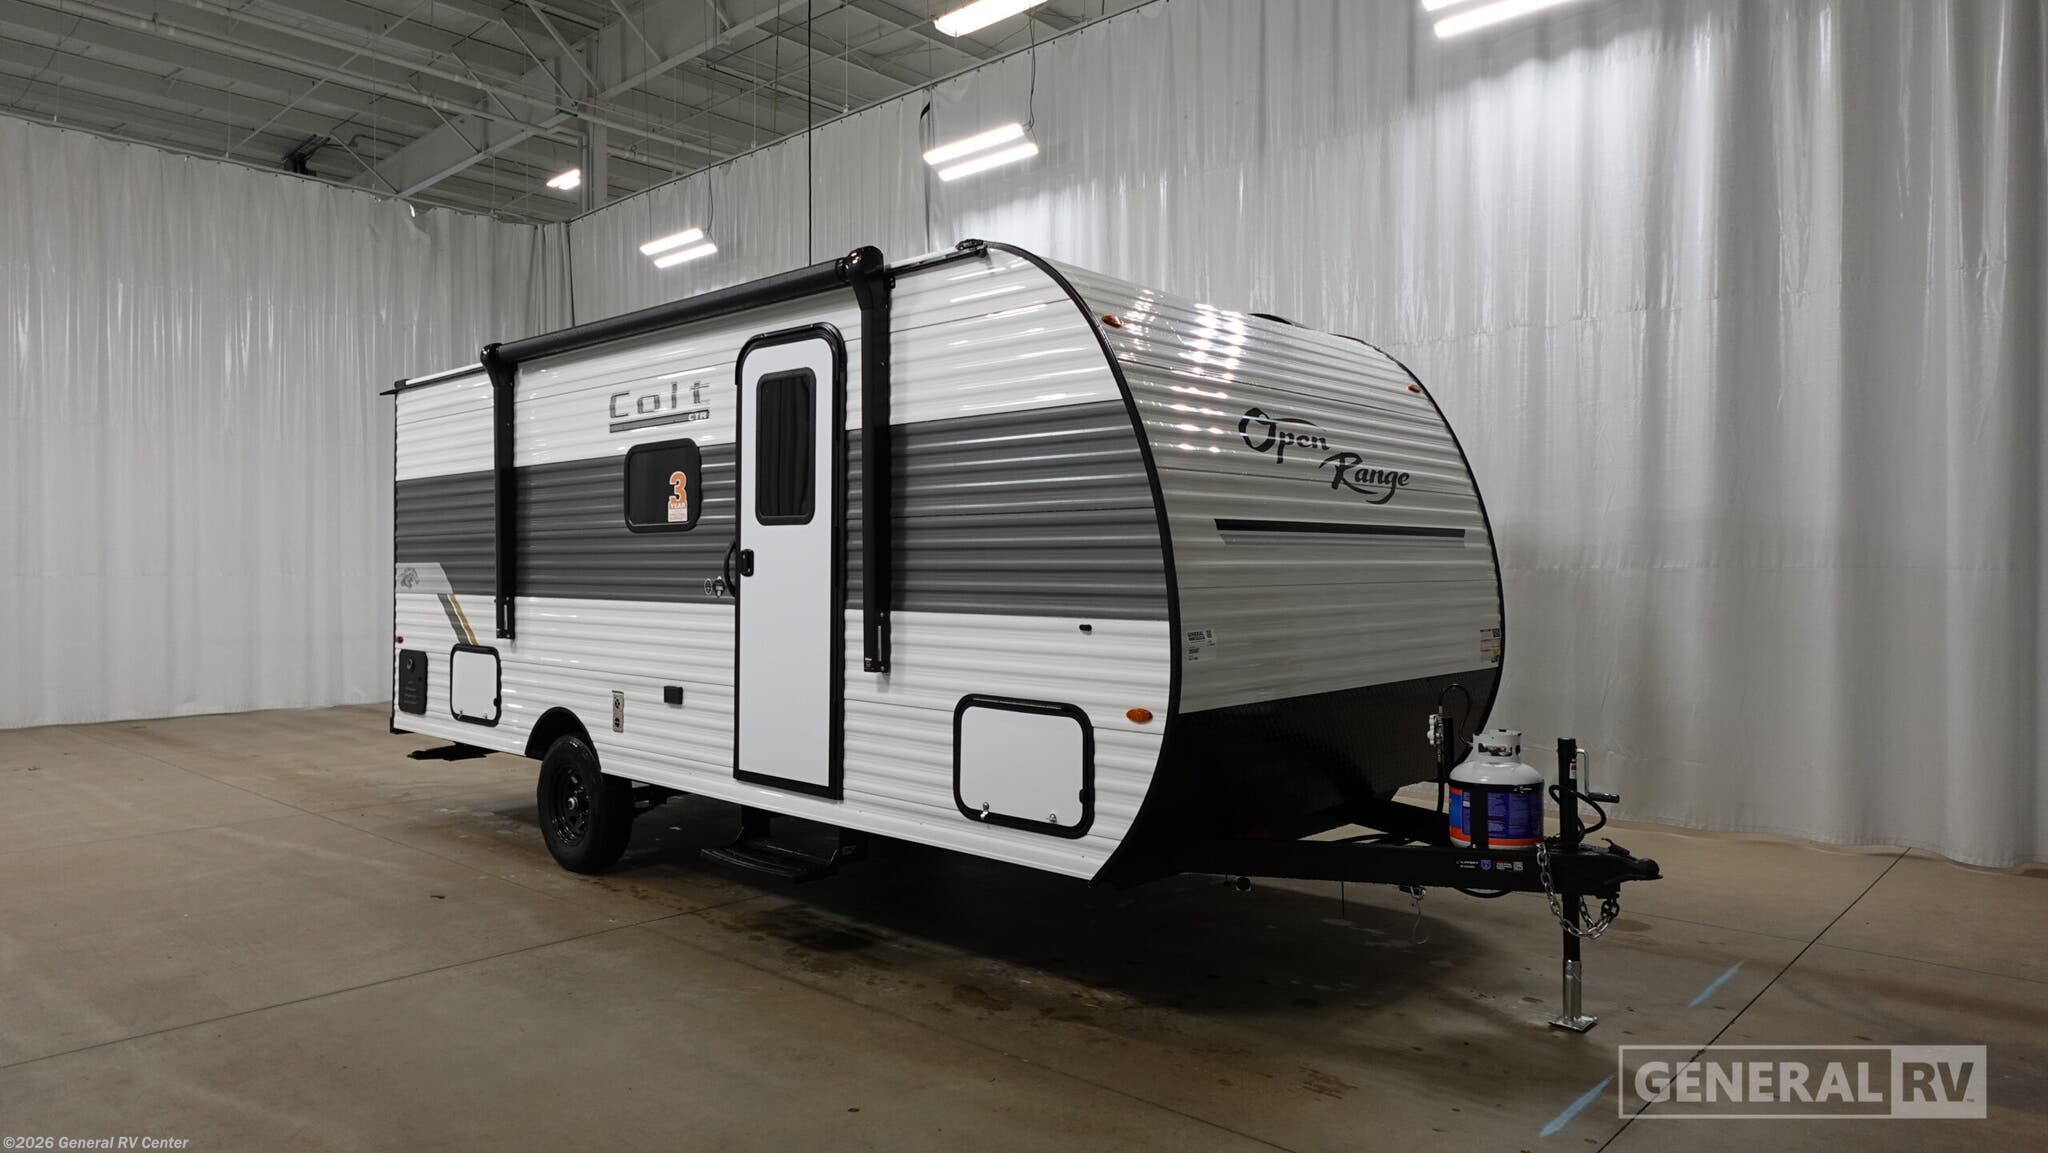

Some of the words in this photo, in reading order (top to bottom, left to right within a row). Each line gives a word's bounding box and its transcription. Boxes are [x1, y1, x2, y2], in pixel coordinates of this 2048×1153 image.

[609, 382, 711, 418] Colt
[688, 411, 708, 421] CTR
[1238, 407, 1330, 464] Open
[669, 471, 687, 504] 3
[1318, 452, 1410, 504] Range
